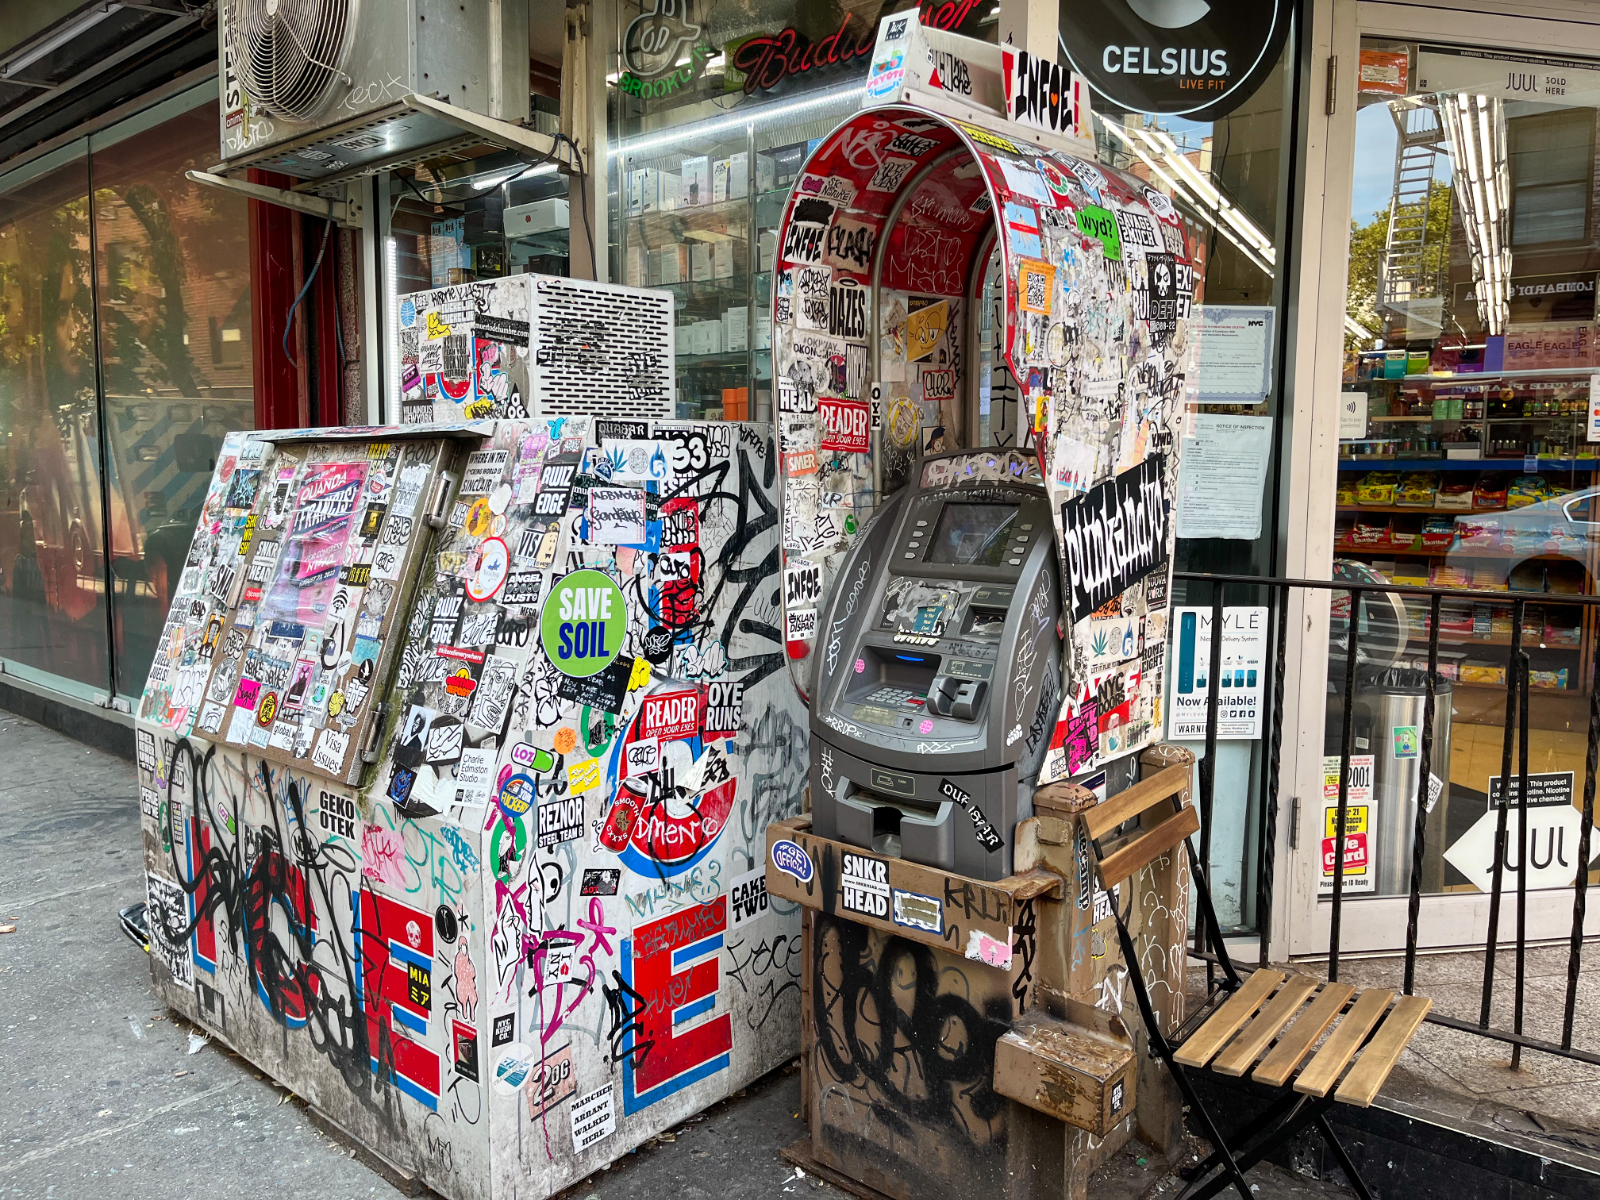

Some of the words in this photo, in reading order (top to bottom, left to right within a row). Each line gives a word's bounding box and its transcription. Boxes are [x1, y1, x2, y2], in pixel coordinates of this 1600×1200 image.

[618, 40, 711, 98] BROOKLYN
[1103, 45, 1227, 76] CELSIUS
[1179, 79, 1204, 90] LIVE
[1208, 80, 1226, 90] FIT
[1506, 72, 1538, 92] JUUL
[1546, 77, 1566, 86] SOLD
[1546, 87, 1565, 95] HERE
[1082, 214, 1113, 239] wyd?
[830, 288, 865, 338] DAZES
[821, 404, 867, 436] READER
[496, 452, 507, 462] THE
[461, 479, 492, 492] SINCLAIR
[536, 492, 567, 515] EDGE
[257, 540, 278, 558] SNKR
[250, 565, 271, 582] HEAD
[508, 573, 541, 583] ANGEL
[559, 587, 613, 621] SAVE
[790, 620, 815, 633] DISPAR
[797, 612, 815, 624] KLAN
[430, 623, 455, 644] EDGE
[557, 621, 610, 660] SOIL
[1142, 642, 1164, 660] ROME
[1142, 653, 1164, 673] EIGHT
[709, 682, 744, 707] OYE
[1099, 672, 1124, 703] NYC
[1176, 697, 1201, 706] Now
[1204, 696, 1256, 706] Aailable!
[646, 697, 697, 729] READER
[705, 706, 740, 731] RUNS
[273, 724, 292, 737] global
[646, 727, 661, 737] OPEN
[663, 726, 679, 735] YOUR
[325, 728, 342, 754] Visa
[313, 746, 341, 774] Issues
[463, 754, 484, 765] Charlie
[513, 747, 535, 762] LOZ
[459, 773, 478, 783] Studio
[461, 764, 488, 774] Edmiston
[1348, 767, 1370, 787] 2001
[522, 781, 533, 793] NEW
[1544, 779, 1567, 787] product
[520, 788, 534, 802] YORK
[1539, 795, 1566, 803] chemical.
[320, 790, 355, 821] GEKO
[614, 797, 639, 818] SMOOTH
[1353, 808, 1359, 816] 21
[319, 810, 355, 841] OTEK
[538, 800, 583, 835] REZNOR
[538, 834, 559, 847] STEEL
[560, 829, 578, 843] TEAM
[578, 827, 584, 836] 6
[776, 852, 806, 879] OFFICIAL
[844, 854, 886, 883] SNKR
[732, 874, 766, 904] CAKE
[1354, 878, 1368, 887] Ready
[733, 892, 768, 923] TWO
[844, 888, 886, 917] HEAD
[410, 966, 430, 988] MIA
[411, 988, 429, 1007] ミア
[495, 1023, 513, 1036] KUSH
[497, 1018, 511, 1030] NYC
[499, 1031, 510, 1040] CO.
[571, 1084, 613, 1112] MARCHER
[574, 1101, 609, 1125] ARRANT
[574, 1112, 610, 1138] WALKED
[582, 1127, 605, 1146] HERE
